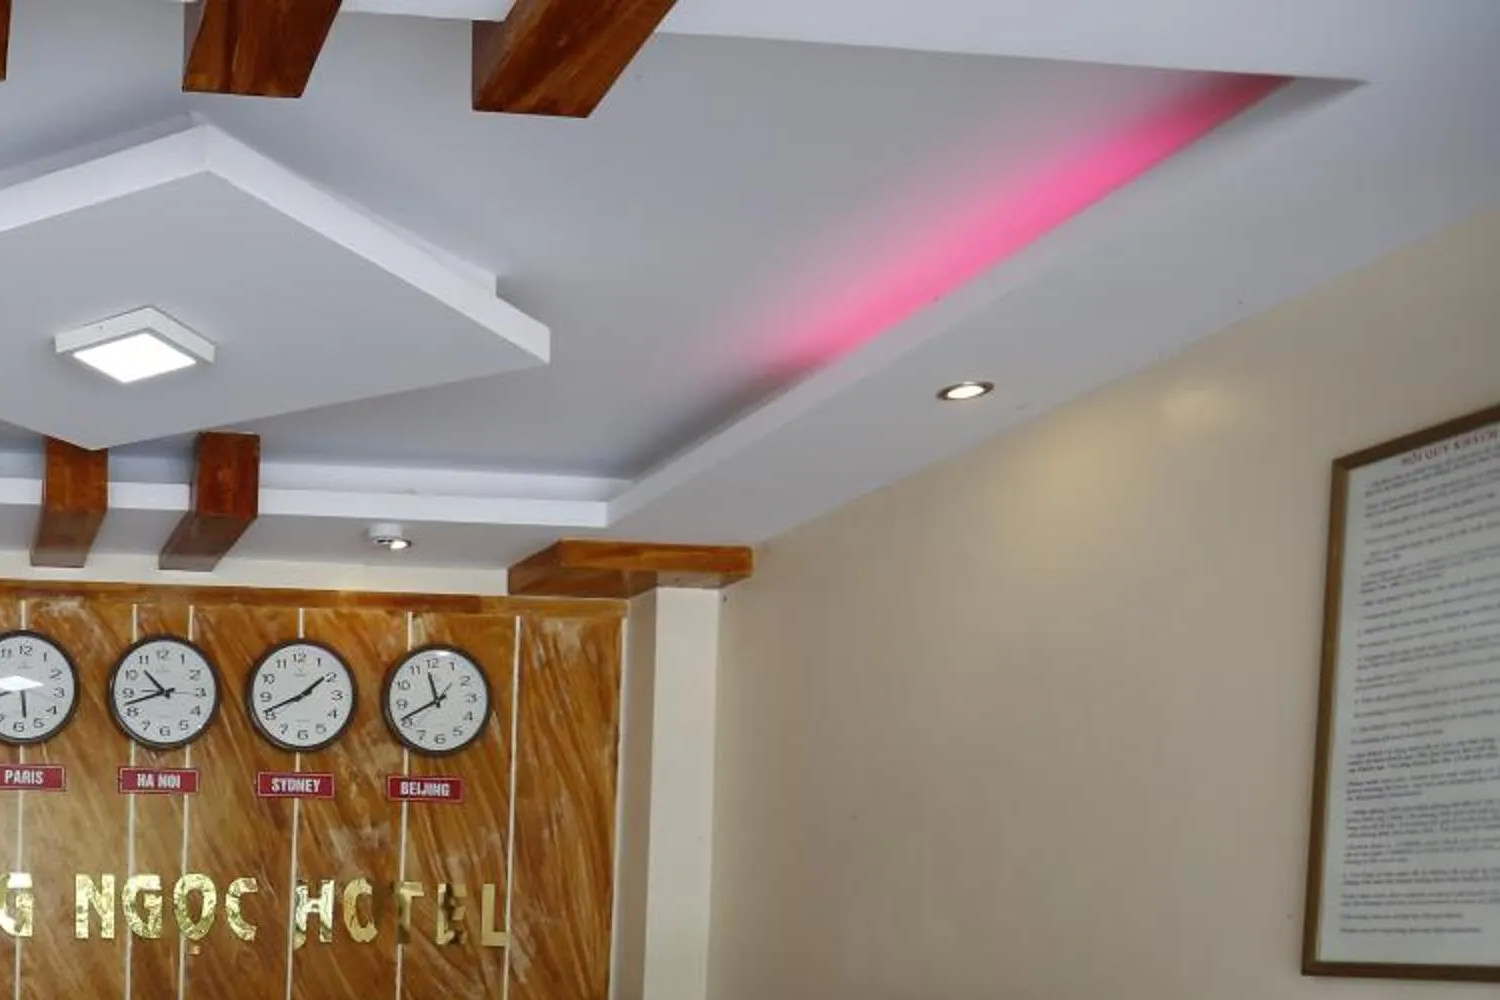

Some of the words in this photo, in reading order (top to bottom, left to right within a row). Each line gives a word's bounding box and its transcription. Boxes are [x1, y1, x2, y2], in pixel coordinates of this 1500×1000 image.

[1, 648, 12, 658] 11
[19, 645, 33, 656] 12
[157, 650, 170, 661] 12
[138, 655, 149, 664] 11
[293, 652, 306, 662] 12
[276, 659, 287, 669] 11
[426, 658, 439, 668] 12
[50, 669, 63, 680] 2
[410, 665, 421, 674] 11
[126, 669, 138, 681] 10
[189, 669, 201, 681] 2
[263, 673, 275, 684] 10
[397, 680, 411, 690] 10
[460, 676, 470, 687] 2
[53, 687, 65, 698] 3
[122, 688, 134, 698] 9
[260, 692, 272, 702] 9
[331, 690, 343, 701] 3
[466, 693, 477, 703] 3
[396, 699, 408, 710] 9
[45, 705, 57, 715] 4
[126, 707, 139, 717] 8
[190, 705, 201, 716] 4
[328, 709, 337, 719] 4
[463, 711, 473, 721] 4
[13, 722, 24, 732] 6
[33, 718, 44, 728] 5
[142, 720, 151, 731] 7
[179, 720, 189, 730] 5
[159, 726, 170, 736] 6
[280, 723, 288, 735] 7
[316, 724, 326, 734] 5
[453, 726, 462, 736] 5
[297, 729, 308, 740] 6
[417, 730, 426, 740] 7
[434, 734, 446, 744] 6
[4, 769, 44, 785] PARIS
[137, 773, 155, 788] HA
[157, 773, 181, 789] NOI
[400, 781, 450, 797] BEIJING
[75, 873, 258, 954] NGỌC
